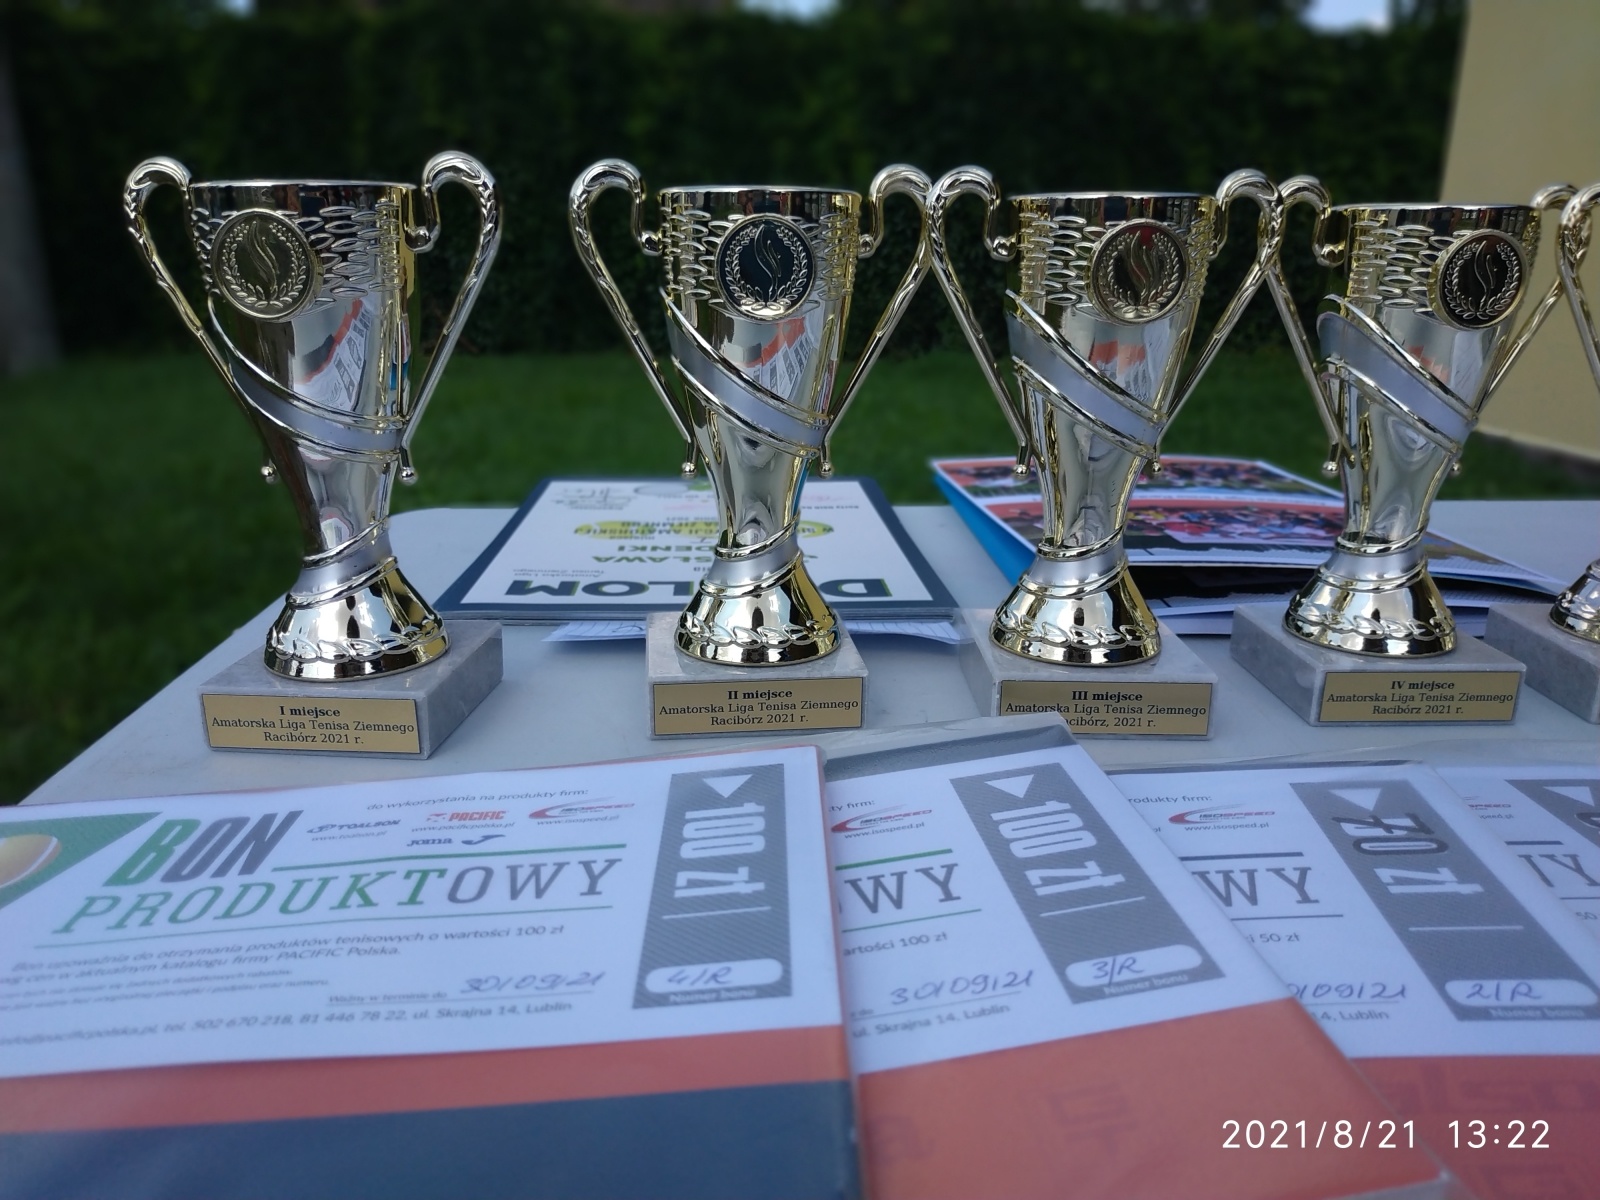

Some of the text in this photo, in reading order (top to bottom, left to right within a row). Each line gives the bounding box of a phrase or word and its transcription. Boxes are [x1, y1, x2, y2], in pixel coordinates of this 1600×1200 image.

[504, 579, 893, 597] DLOM
[1390, 680, 1455, 692] IV miejsce
[727, 689, 793, 701] II miejsce
[1071, 691, 1143, 703] III miejsce
[1327, 693, 1514, 704] Amatorska Liga Tenisa Ziemnego
[279, 705, 341, 718] I miejsce
[659, 700, 859, 715] Amatorska Liga Tenisa Ziemnego
[1005, 703, 1207, 717] Amatorska Liga Tenisa Ziemnego
[1372, 705, 1464, 715] Racibórz 2021 r.
[212, 717, 415, 734] Amatorska Liga Tenisa Ziemnego
[710, 713, 809, 725] Racibórz 2021 r.
[1064, 717, 1157, 728] cibórz, 2021 r.
[264, 732, 364, 744] Racibórz 2021 r.
[366, 803, 383, 811] do
[387, 795, 476, 809] wykorzystania
[498, 791, 556, 801] produkty
[847, 800, 875, 809] firm:
[1128, 794, 1212, 804] rodukty firm:
[449, 810, 506, 822] PACIFIC
[680, 802, 765, 859] 100
[844, 822, 925, 839] www.isospeed.pl
[990, 800, 1098, 858] 100
[1184, 822, 1269, 832] www.isospeed.pl
[102, 810, 304, 887] BON
[674, 866, 765, 898] zł
[1024, 860, 1125, 896] zł
[51, 858, 623, 935] PRODUKTOWY
[839, 863, 962, 915] WY
[157, 944, 242, 960] otrzymania
[245, 938, 332, 952] produktów
[335, 931, 424, 945] tenisowych
[444, 927, 510, 939] wartości
[515, 925, 546, 936] 100
[1259, 932, 1281, 943] 50
[842, 939, 895, 957] artości
[899, 934, 930, 947] 100
[160, 957, 227, 971] katalogu
[231, 954, 274, 965] firmy
[276, 947, 344, 962] PACIFIC
[226, 1016, 259, 1029] 670
[300, 1013, 319, 1025] 81
[360, 1011, 380, 1021] 78
[435, 1006, 492, 1019] Skrajna
[526, 1001, 573, 1014] Lublin
[875, 1018, 932, 1035] Skrajna
[963, 1004, 1010, 1020] Lublin
[1339, 1010, 1389, 1021] Lublin
